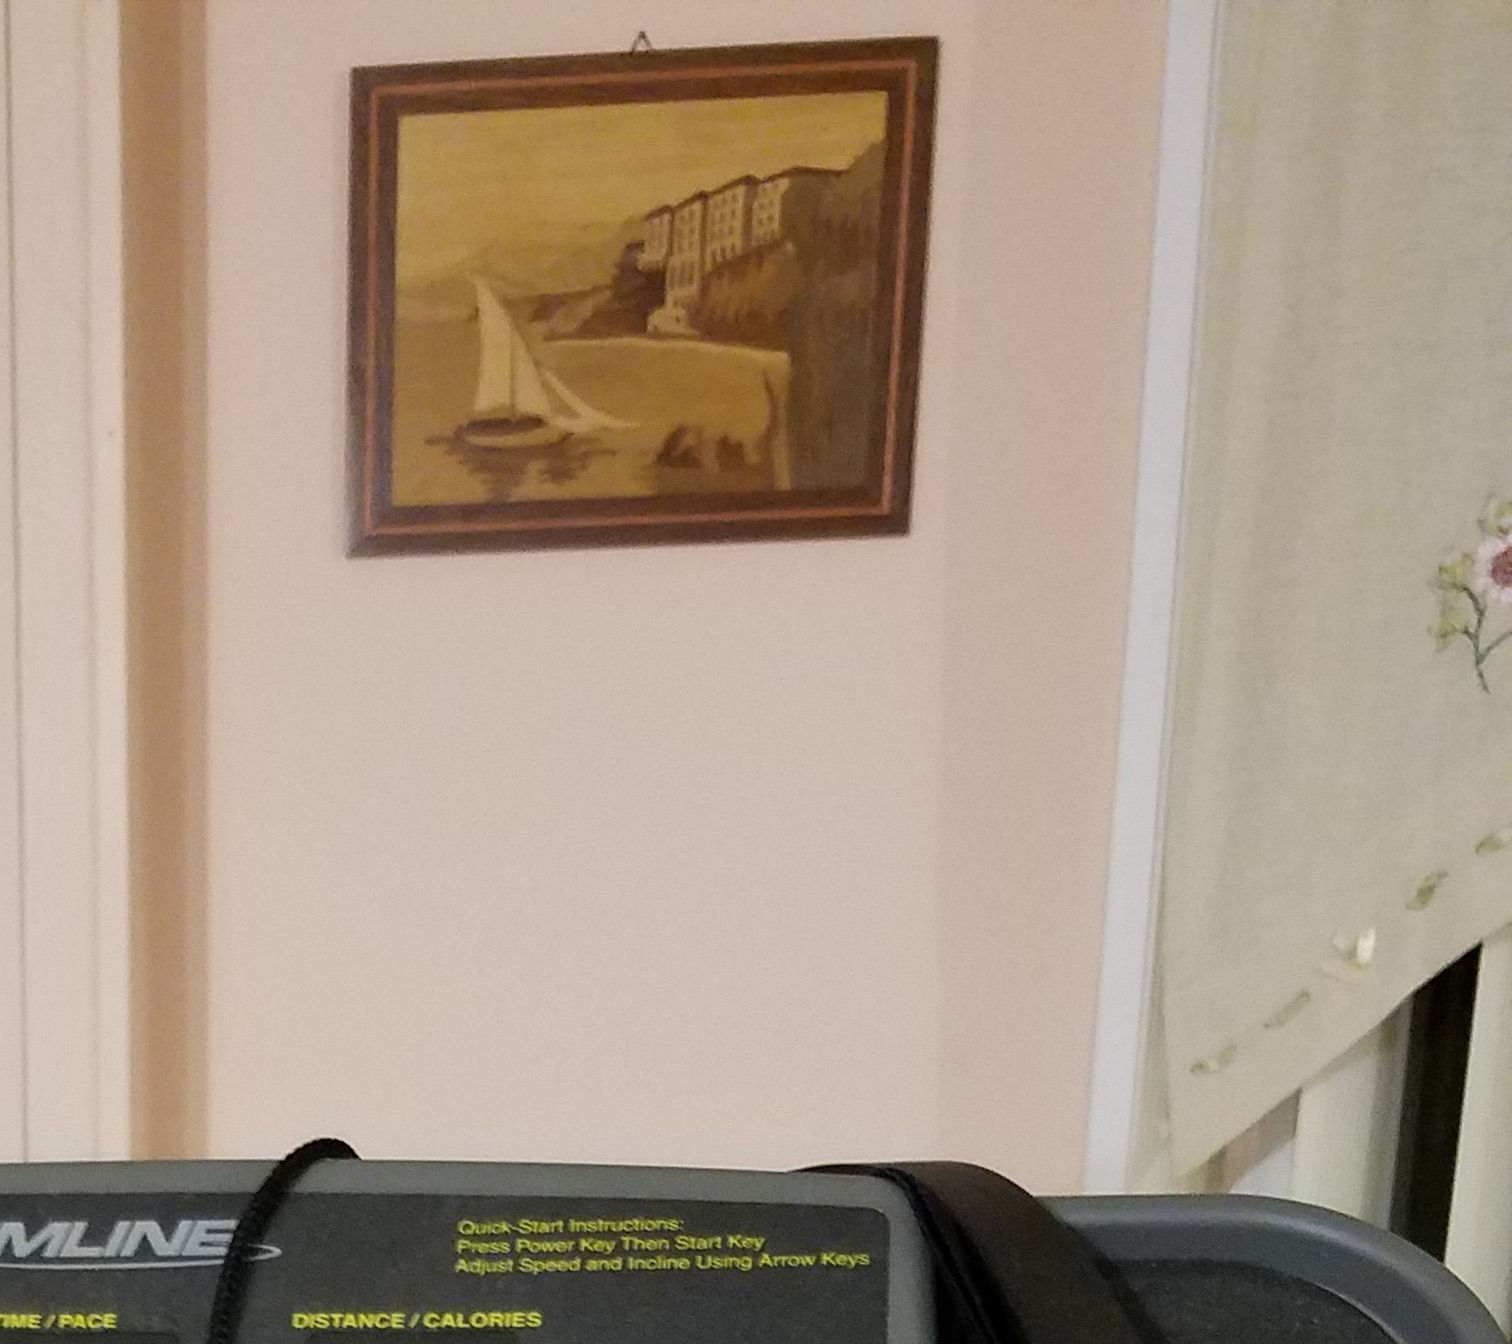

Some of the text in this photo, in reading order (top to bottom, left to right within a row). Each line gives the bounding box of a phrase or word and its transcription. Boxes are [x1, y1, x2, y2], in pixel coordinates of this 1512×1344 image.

[457, 1217, 684, 1235] Quick-Start Instructions:
[455, 1234, 766, 1254] Press Power Key Then Start Key
[454, 1252, 870, 1276] Adjust Speed and Incline Using Arrow Keys
